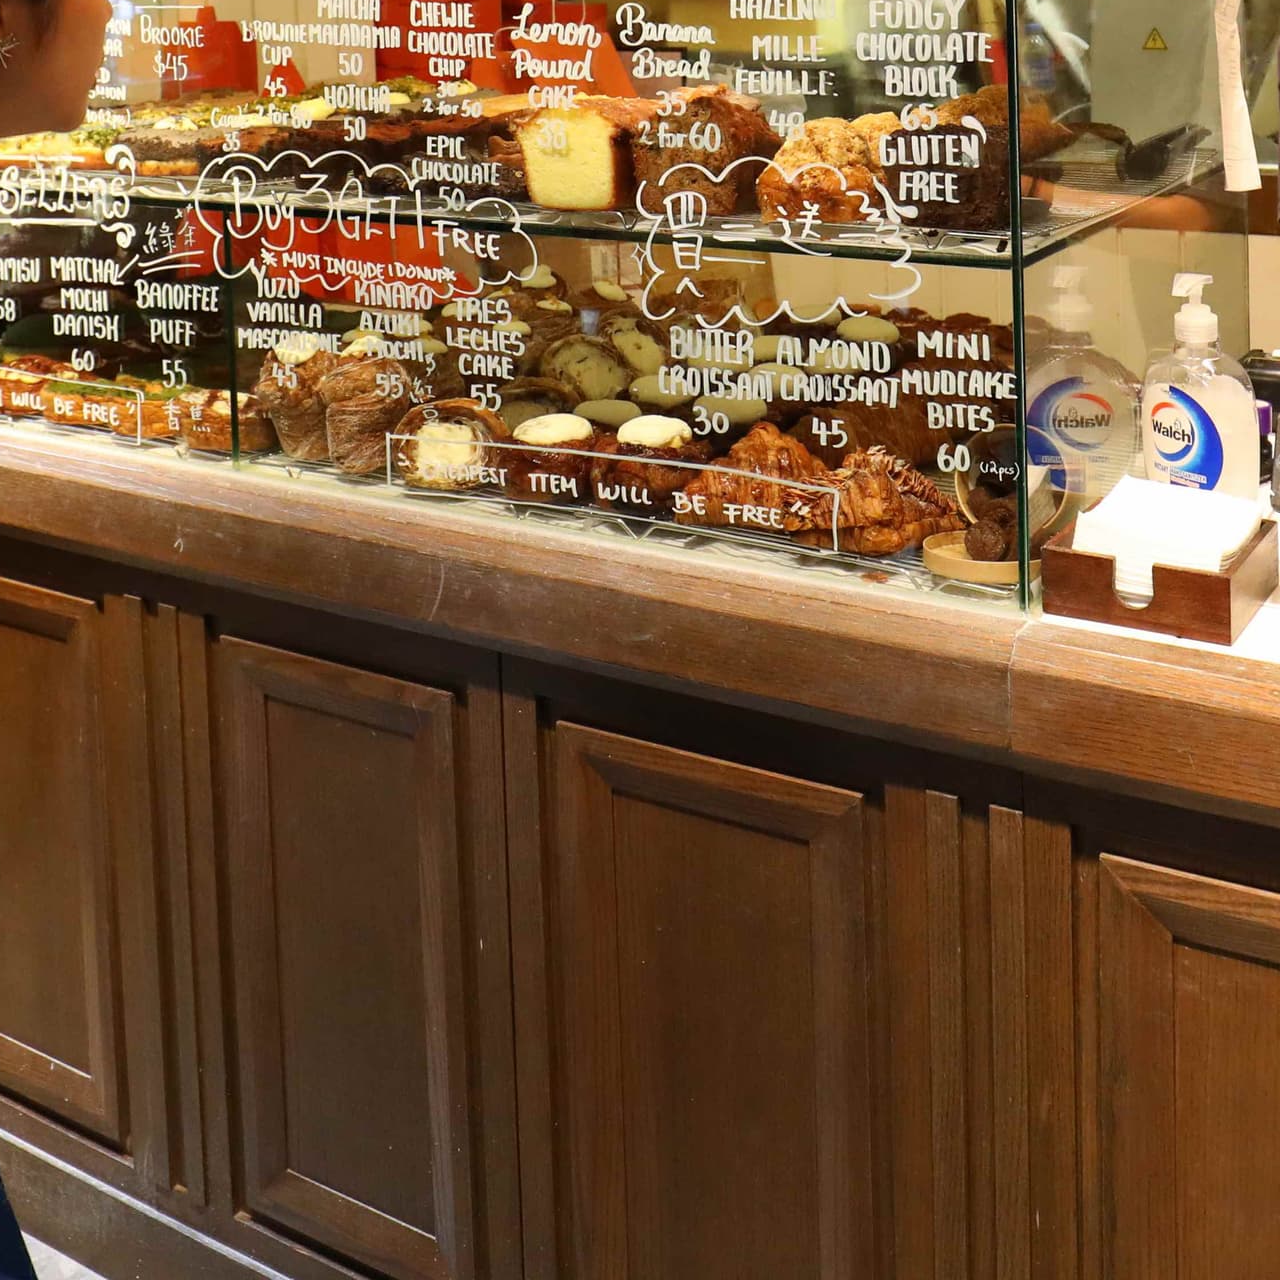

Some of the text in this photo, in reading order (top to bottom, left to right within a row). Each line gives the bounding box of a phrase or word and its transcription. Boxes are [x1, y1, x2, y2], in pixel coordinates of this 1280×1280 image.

[410, 0, 475, 28] CHEWIE
[511, 2, 601, 48] Lemon
[616, 2, 716, 46] Banana
[242, 19, 307, 43] BROWNIE
[306, 23, 401, 49] MACADAMIA
[408, 31, 496, 59] CHOCOLATE
[262, 45, 293, 66] CUP
[752, 34, 827, 63] MILLE
[856, 31, 994, 63] CHOCOLATE
[153, 50, 188, 81] $45
[338, 53, 363, 76] 50
[428, 57, 466, 78] CHIP
[511, 48, 594, 82] Pound
[631, 47, 711, 81] Bread
[263, 74, 288, 98] 45
[884, 64, 960, 99] BLOCK
[324, 84, 390, 113] HOJICHA
[422, 99, 482, 118] 2 for 50
[528, 84, 580, 111] CAKE
[656, 90, 687, 117] 35
[268, 103, 289, 124] for
[769, 109, 805, 141] 48
[900, 102, 938, 132] 65
[222, 131, 240, 152] 35
[343, 116, 366, 142] 50
[638, 120, 721, 153] 2 for 60
[427, 135, 466, 160] EPIC
[879, 133, 980, 169] GLUTEN
[411, 158, 501, 185] CHOCOLATE
[438, 187, 465, 211] 50
[899, 170, 960, 204] FREE
[222, 165, 296, 251] Buy
[300, 174, 334, 234] 3
[431, 220, 501, 261] FREE
[51, 256, 118, 284] MATCHA
[282, 251, 321, 270] MUST
[60, 288, 108, 311] MOCHI
[134, 279, 219, 312] BANOFFEE
[247, 302, 322, 329] VANILLA
[359, 310, 420, 336] AZUKI
[453, 298, 512, 324] TRES
[53, 314, 119, 342] DANISH
[150, 319, 196, 346] PUFF
[446, 327, 525, 357] LECHES
[71, 349, 94, 371] 60
[367, 338, 424, 362] MOCHI
[670, 325, 754, 367] BUTTER
[776, 335, 891, 373] ALMOND
[917, 330, 990, 362] MINI
[162, 359, 187, 389] 55
[272, 363, 298, 390] 45
[458, 355, 515, 379] CAKE
[375, 373, 404, 399] 55
[658, 365, 776, 402] CROISSANT
[780, 373, 900, 409] CROISSANT
[902, 369, 1018, 400] MUDCAKE
[11, 389, 46, 410] WILL
[54, 399, 73, 416] BE
[470, 385, 501, 412] 55
[692, 405, 730, 436] 30
[926, 401, 995, 433] BITES
[811, 417, 848, 449] 45
[1152, 419, 1191, 444] Walch
[937, 443, 970, 472] 60
[598, 482, 652, 505] WILL
[672, 492, 706, 516] BE
